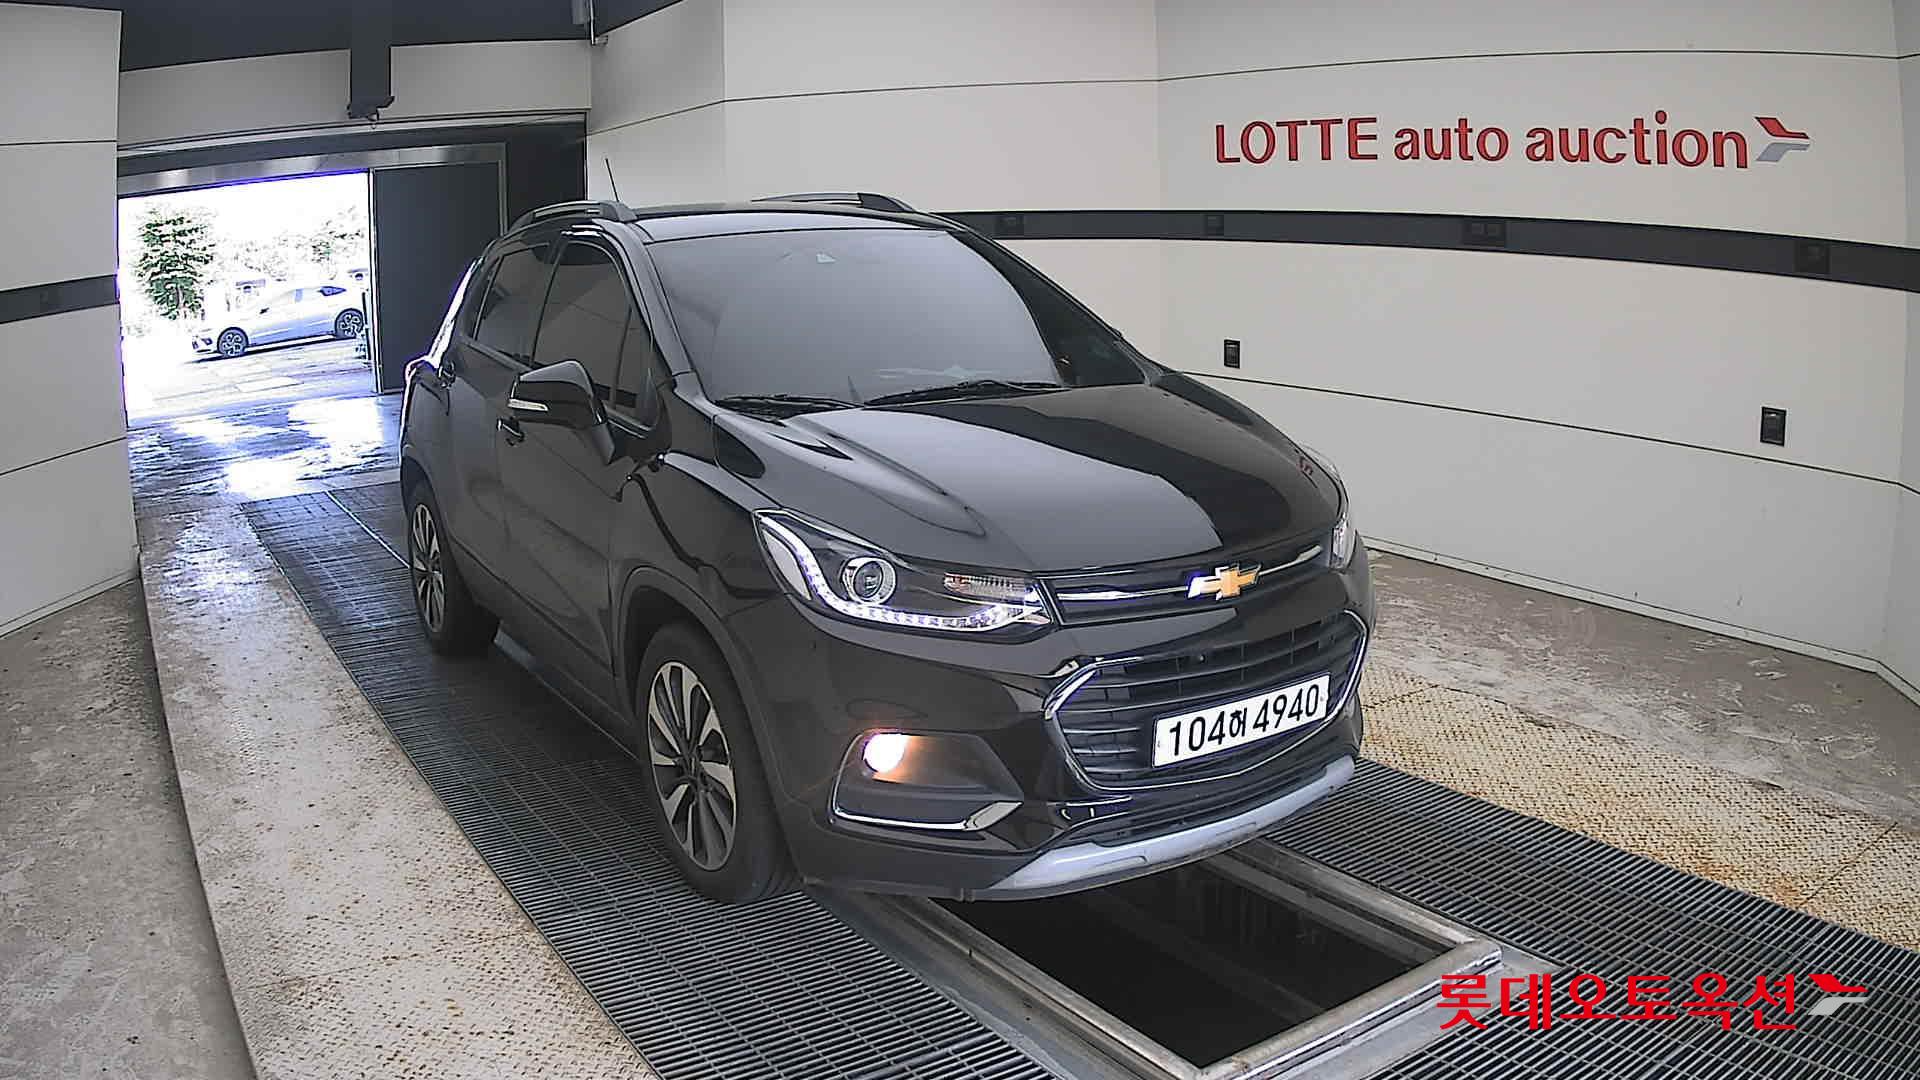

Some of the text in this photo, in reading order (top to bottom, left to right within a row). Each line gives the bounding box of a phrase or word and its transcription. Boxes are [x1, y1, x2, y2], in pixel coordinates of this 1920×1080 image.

[1215, 110, 1749, 169] LOTTE auto auction
[1169, 684, 1320, 756] 104허 4940
